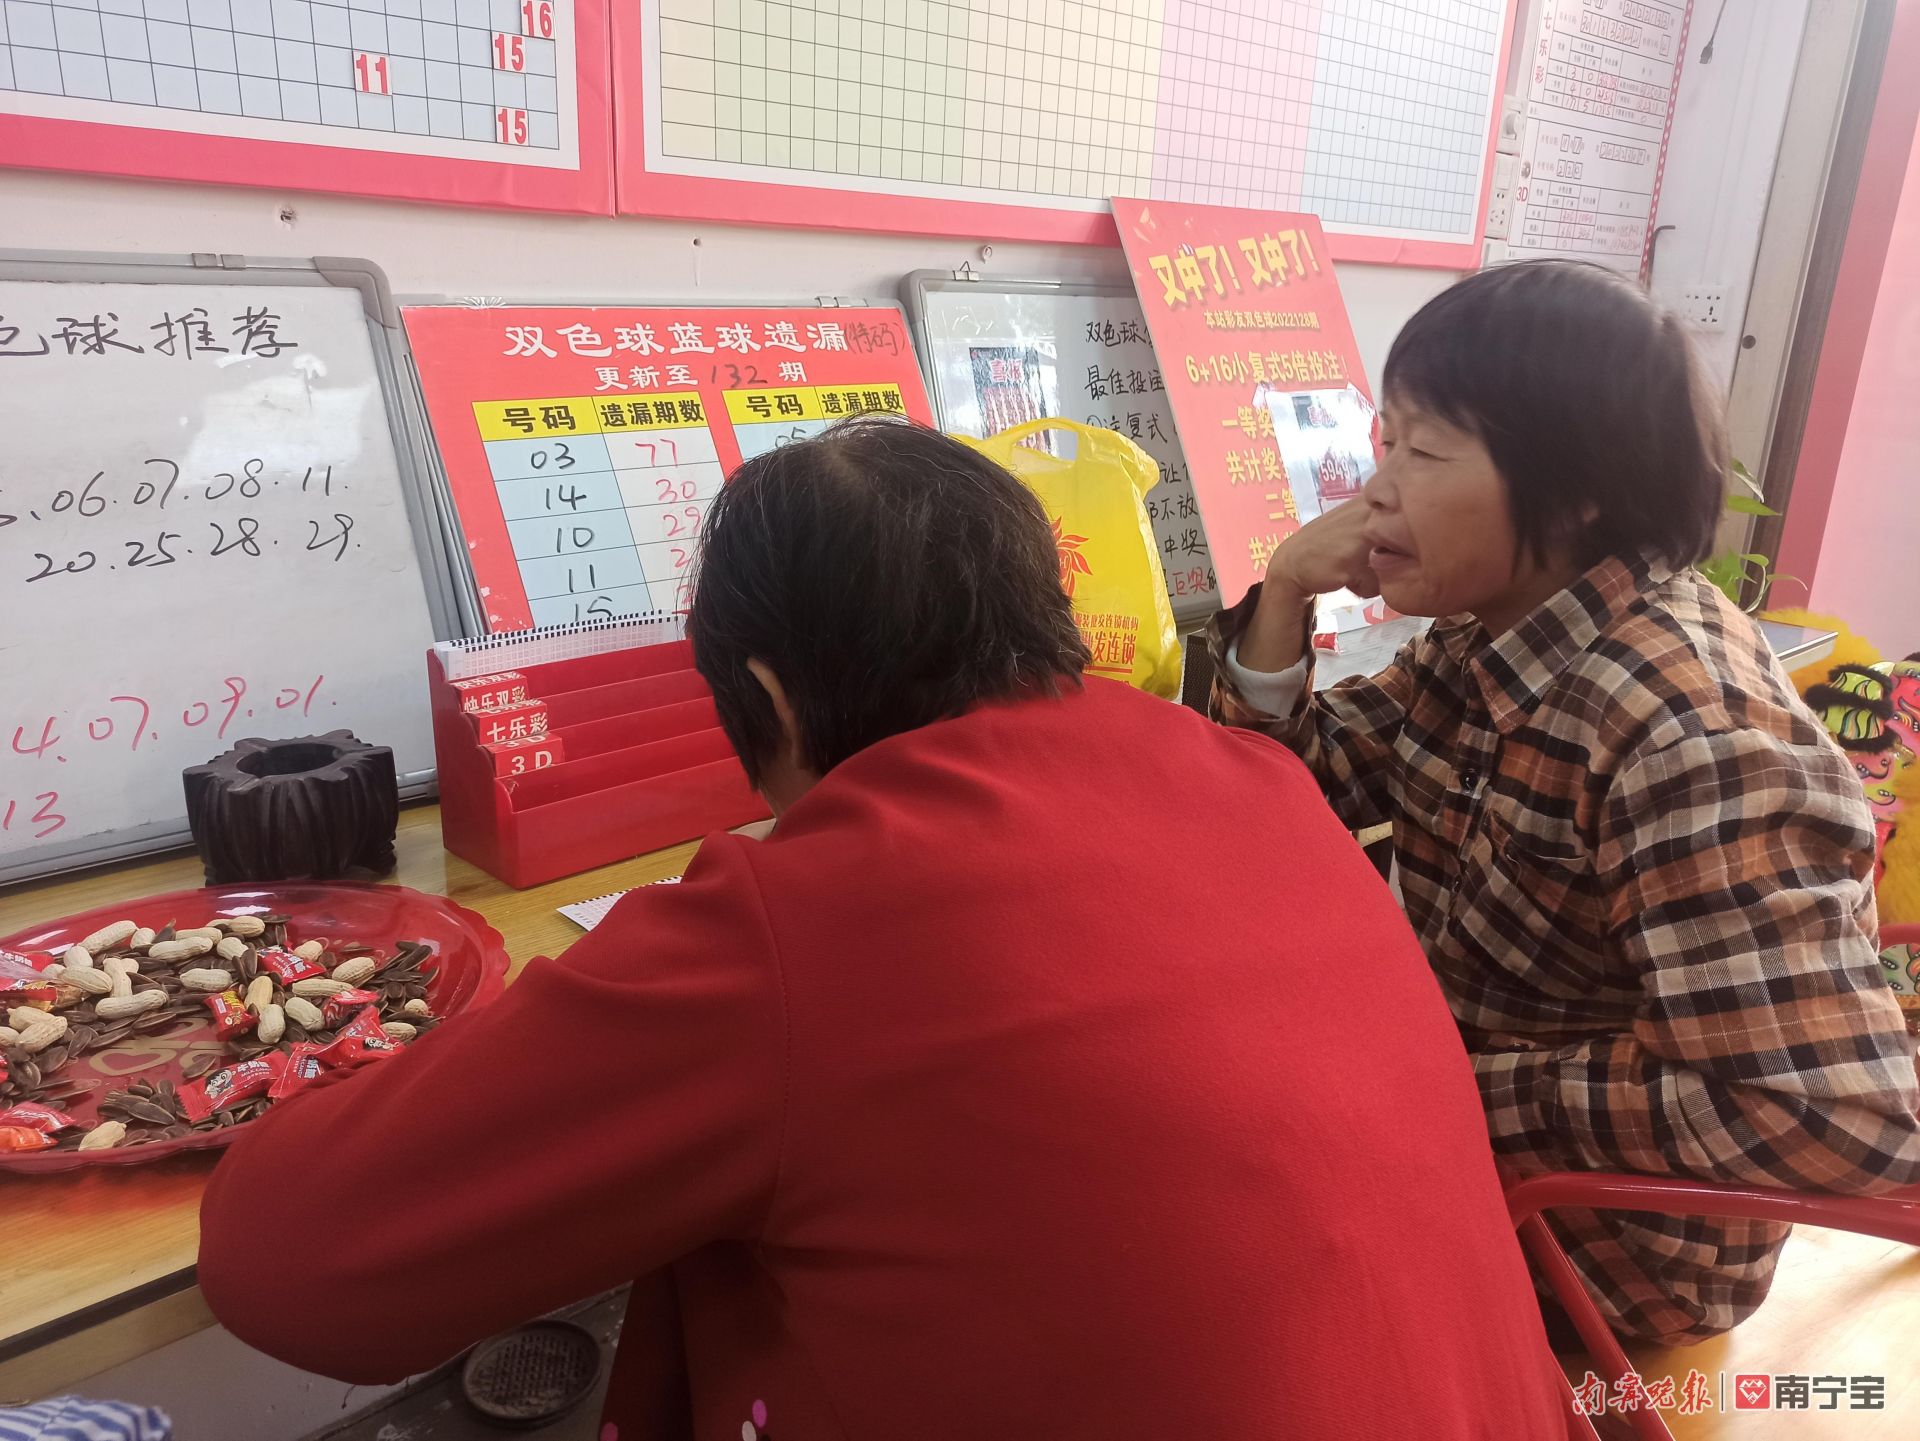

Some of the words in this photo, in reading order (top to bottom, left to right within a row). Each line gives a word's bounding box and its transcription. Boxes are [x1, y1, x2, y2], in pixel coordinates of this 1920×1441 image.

[522, 1, 554, 38] 16
[494, 33, 526, 72] 15
[355, 53, 390, 94] 11
[497, 109, 529, 145] 15
[1516, 186, 1528, 203] 3D
[1238, 229, 1321, 286] 又中了！
[502, 320, 848, 358] 双色球蓝球遗漏
[1086, 320, 1154, 348] 双色球
[593, 365, 700, 391] 更新至
[709, 363, 769, 389] 132
[778, 360, 808, 384] 期
[600, 398, 708, 430] 遗漏期数
[745, 392, 804, 419] 号码
[821, 389, 904, 415] 遗漏期数
[502, 404, 577, 434] 号码
[1222, 406, 1275, 440] 一等奖
[530, 442, 577, 470] 03
[634, 438, 679, 469] 77
[1225, 447, 1289, 486] 共计奖
[545, 484, 588, 513] 14
[556, 527, 595, 553] 10
[1249, 531, 1294, 571] 共计
[567, 565, 597, 594] 11
[463, 685, 526, 712] 快乐双彩
[487, 712, 549, 743] 七乐彩
